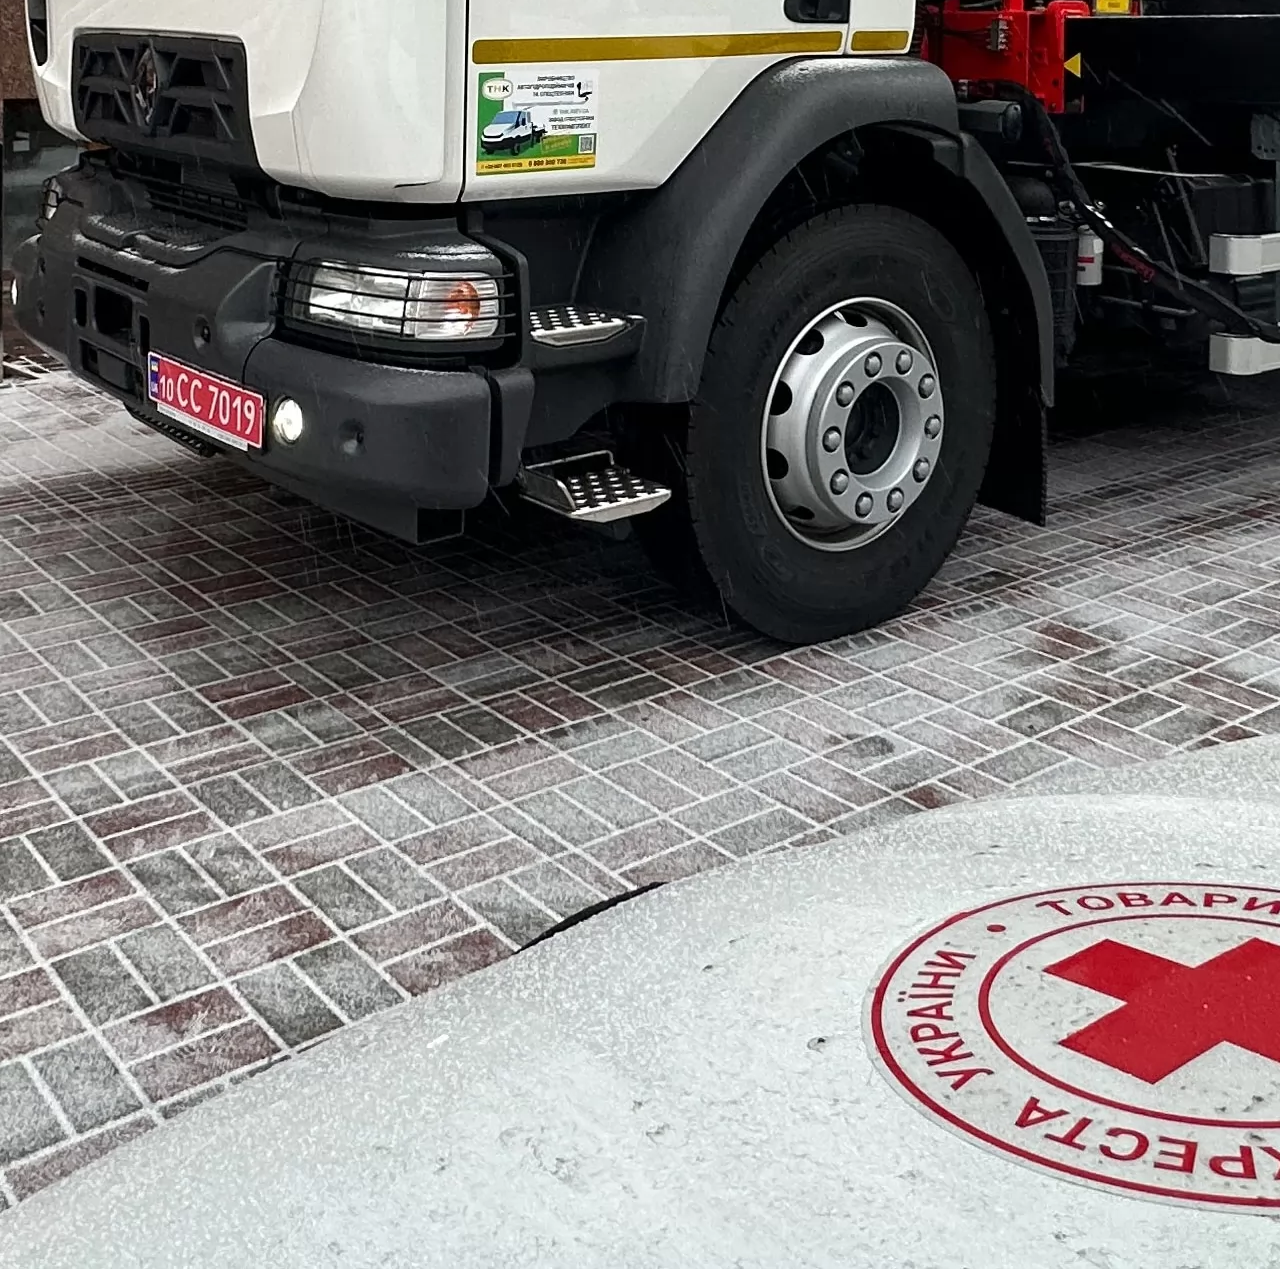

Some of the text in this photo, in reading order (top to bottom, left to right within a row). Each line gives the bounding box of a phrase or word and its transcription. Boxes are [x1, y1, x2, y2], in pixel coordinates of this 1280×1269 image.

[176, 372, 203, 414] CC
[208, 384, 256, 436] 7019
[897, 949, 995, 1092] УКРАЇНИ
